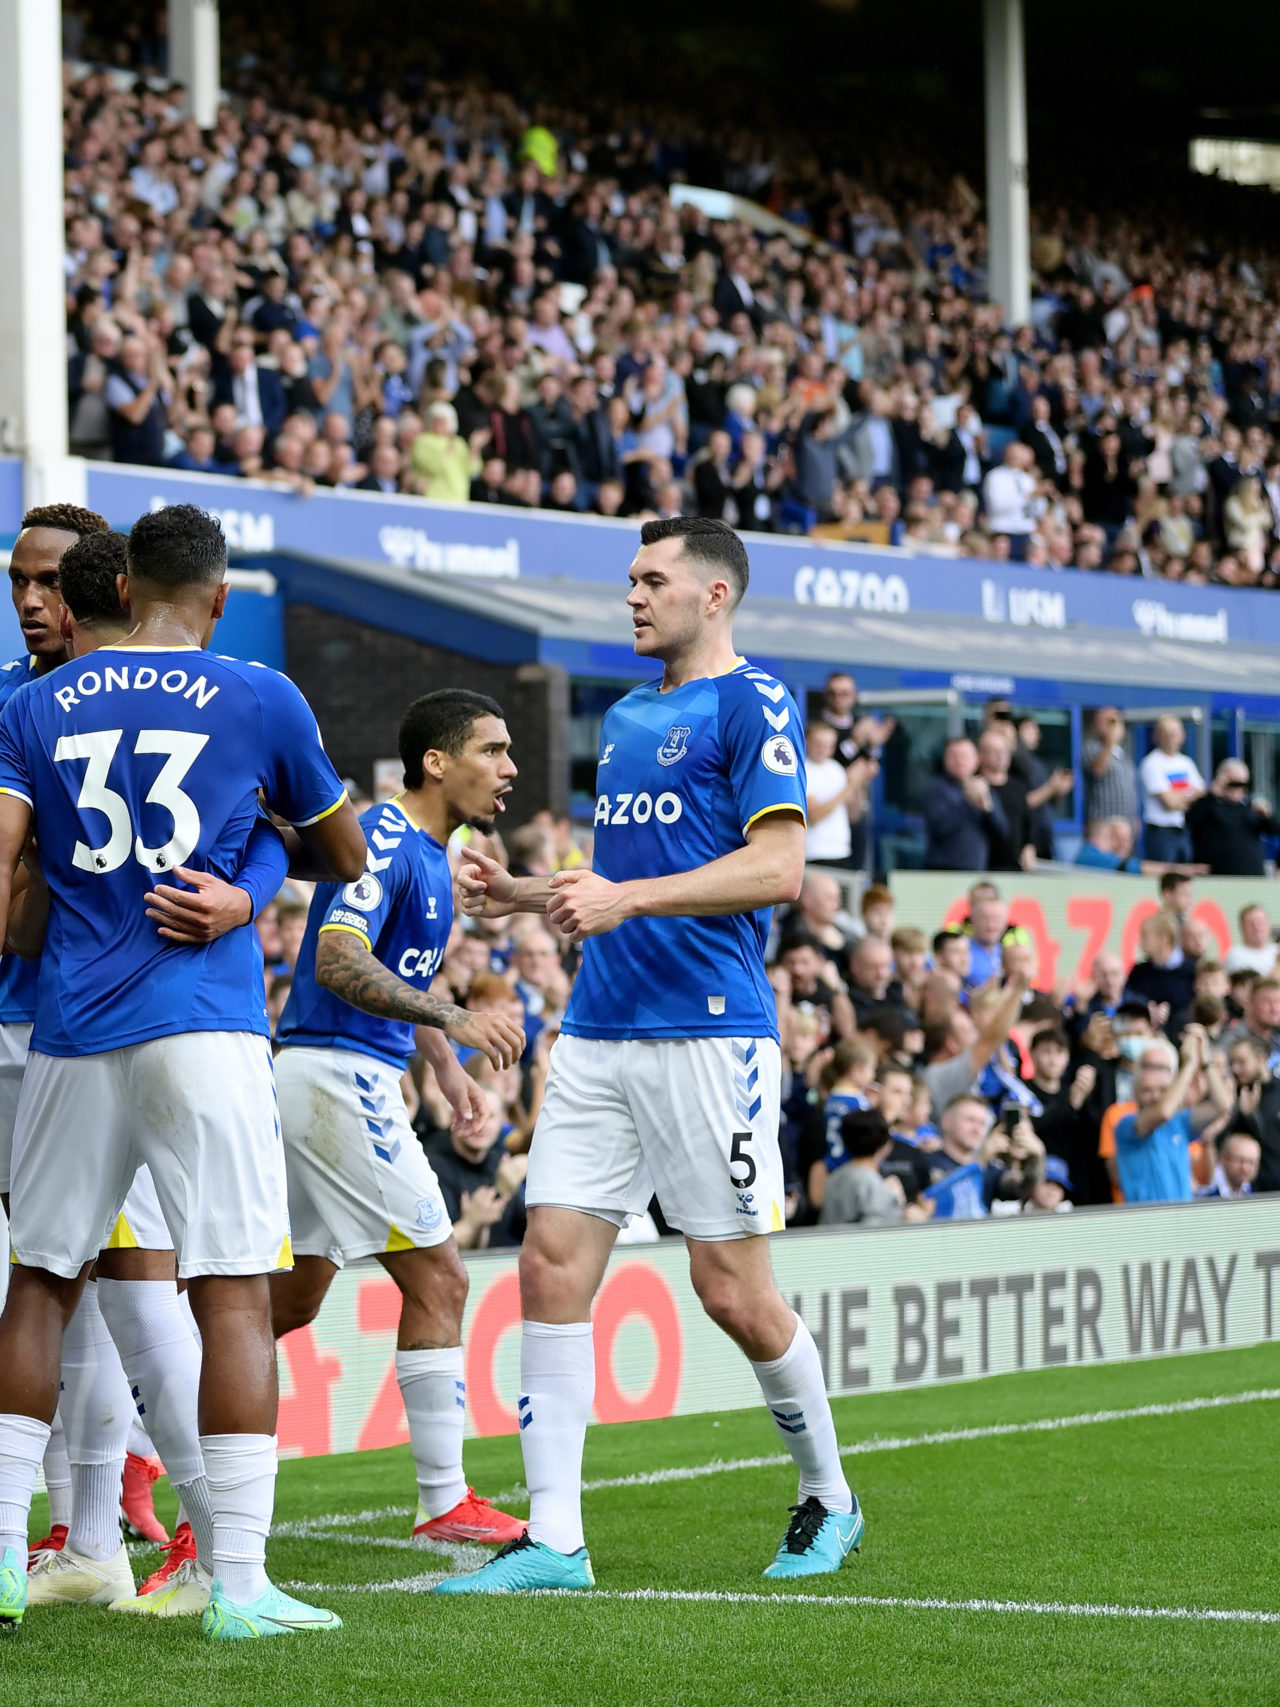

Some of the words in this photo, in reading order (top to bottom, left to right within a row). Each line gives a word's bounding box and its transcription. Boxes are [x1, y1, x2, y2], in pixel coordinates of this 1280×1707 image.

[54, 666, 220, 713] RONDON
[53, 728, 210, 874] 33
[730, 1132, 757, 1189] 5
[893, 1268, 1104, 1384] BETTER
[1122, 1253, 1239, 1354] WAY
